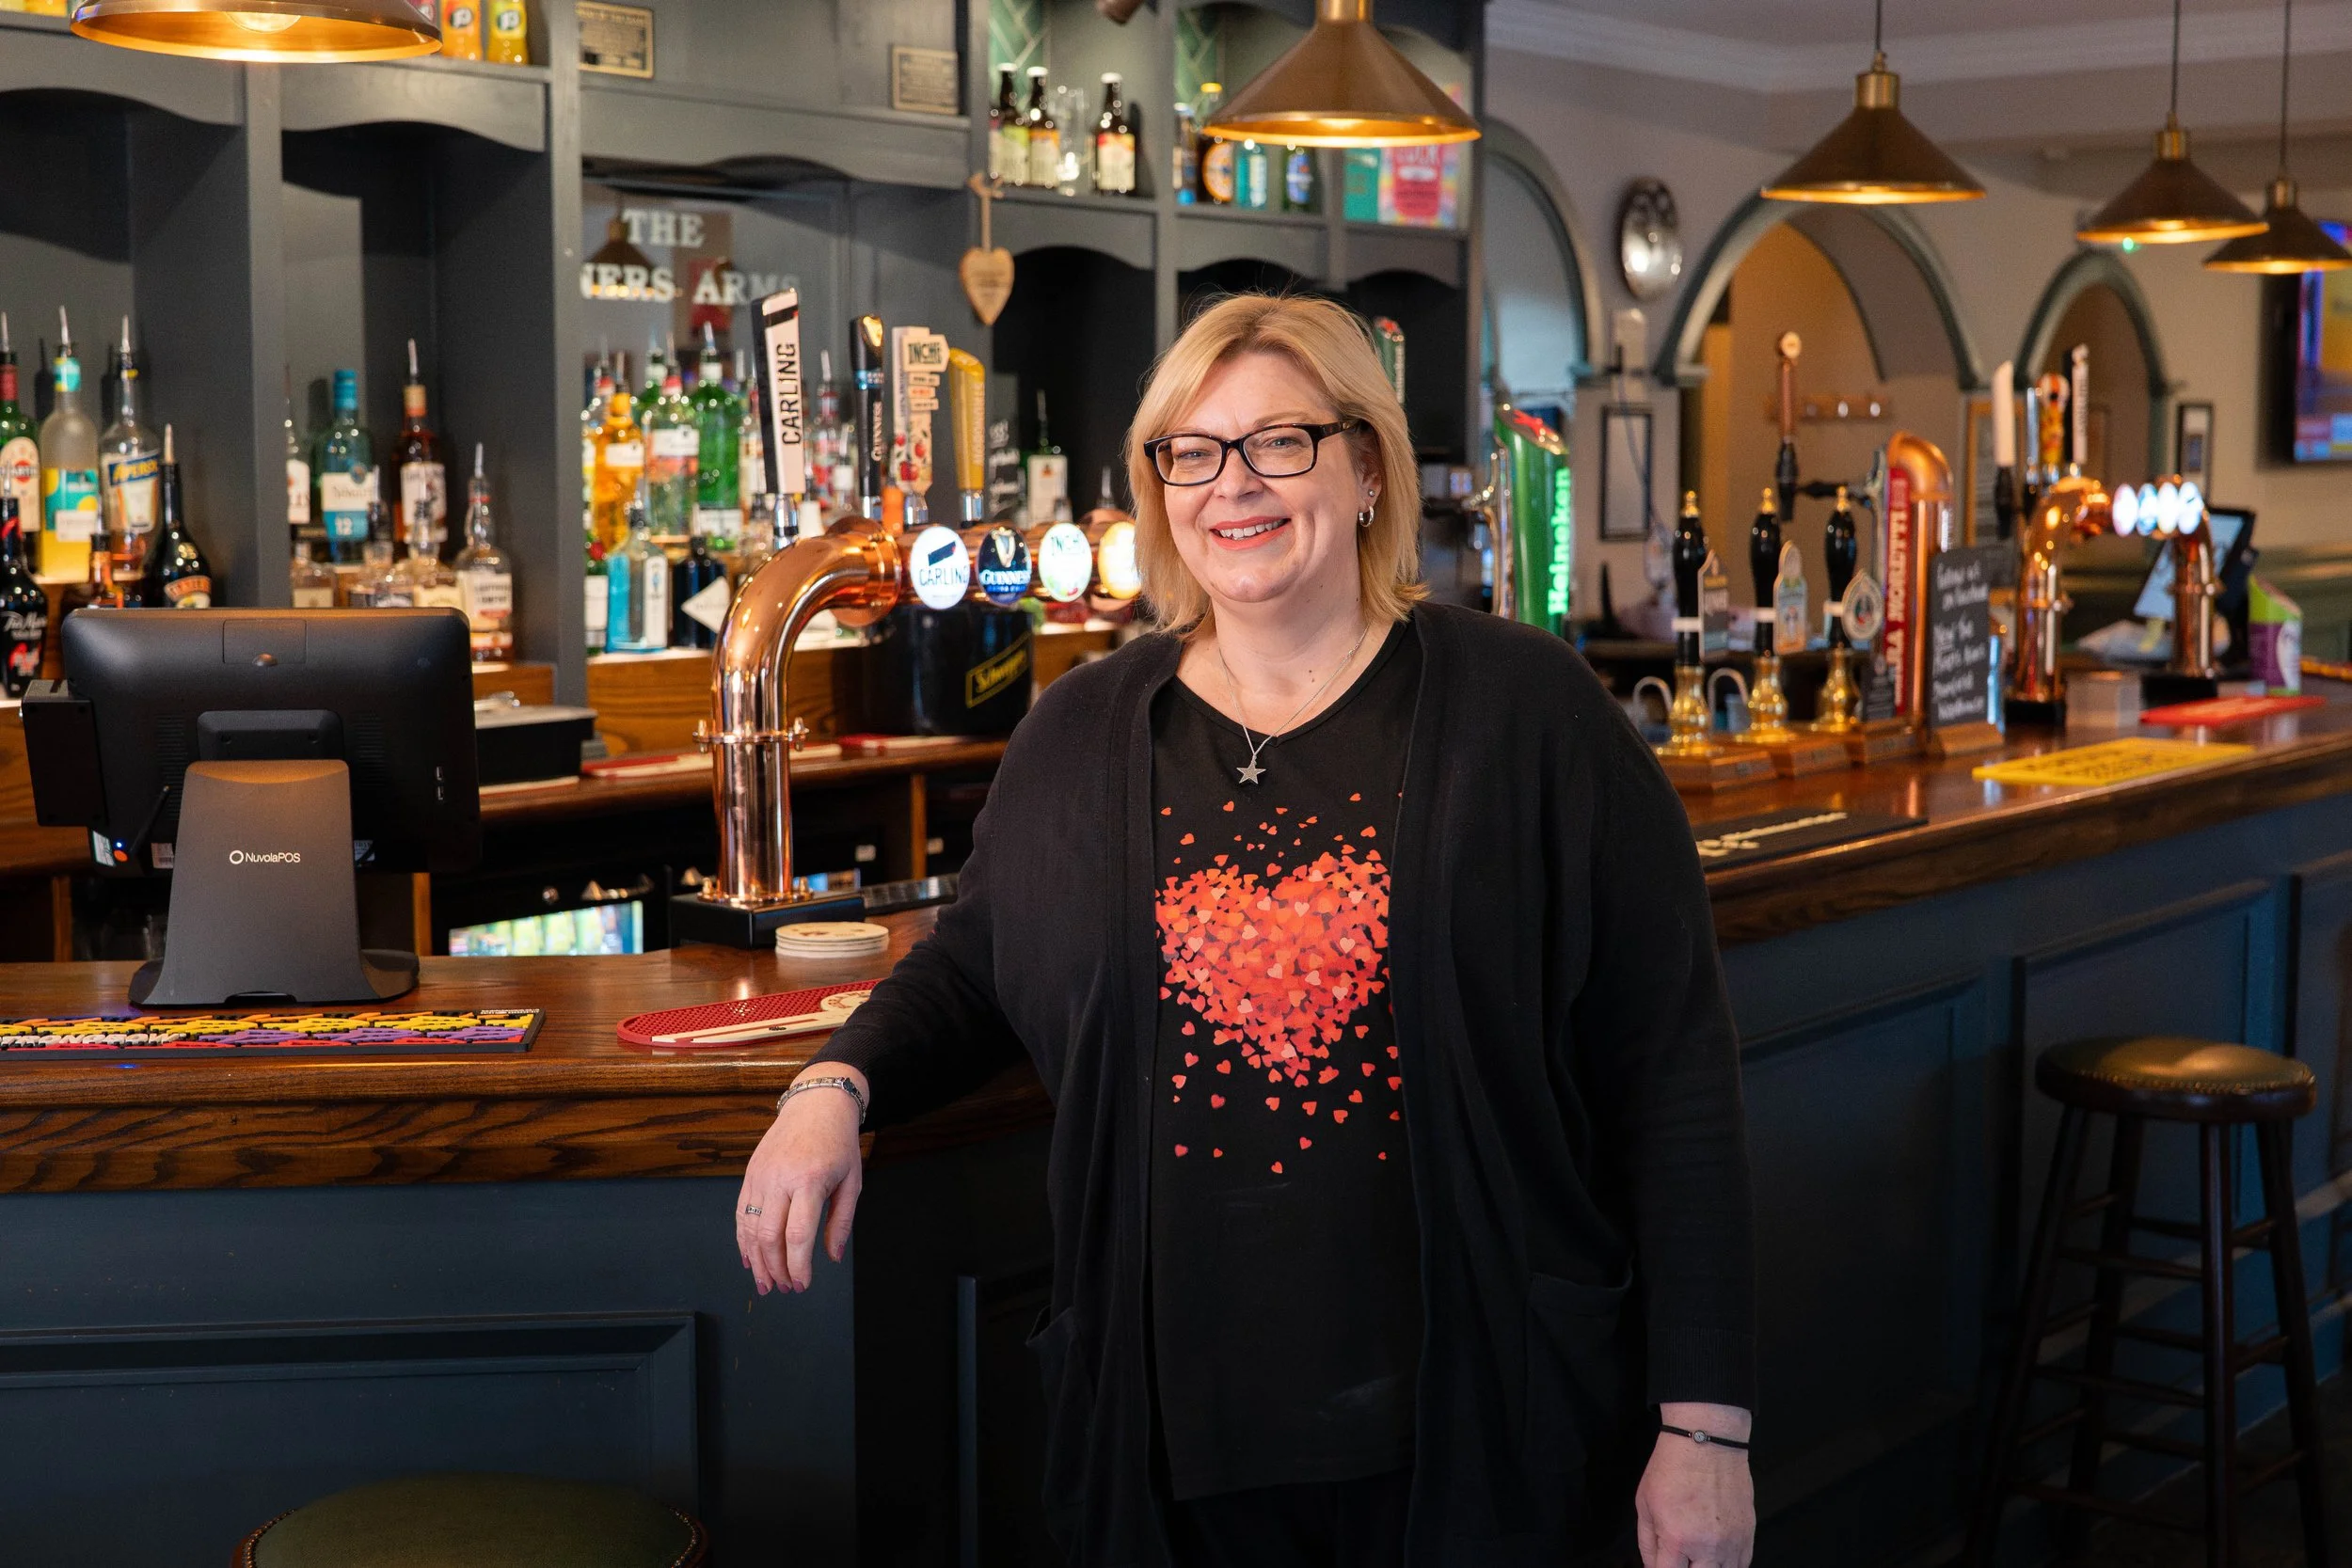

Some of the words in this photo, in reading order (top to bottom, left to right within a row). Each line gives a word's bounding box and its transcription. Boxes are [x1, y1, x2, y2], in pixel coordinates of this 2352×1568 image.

[622, 208, 705, 248] THE
[776, 342, 802, 446] CARLING
[871, 400, 883, 462] GUINNESS
[334, 516, 354, 536] 12
[1548, 467, 1570, 615] Heineken
[1887, 509, 1908, 623] MORETTI
[245, 852, 301, 863] NuvolaPOS
